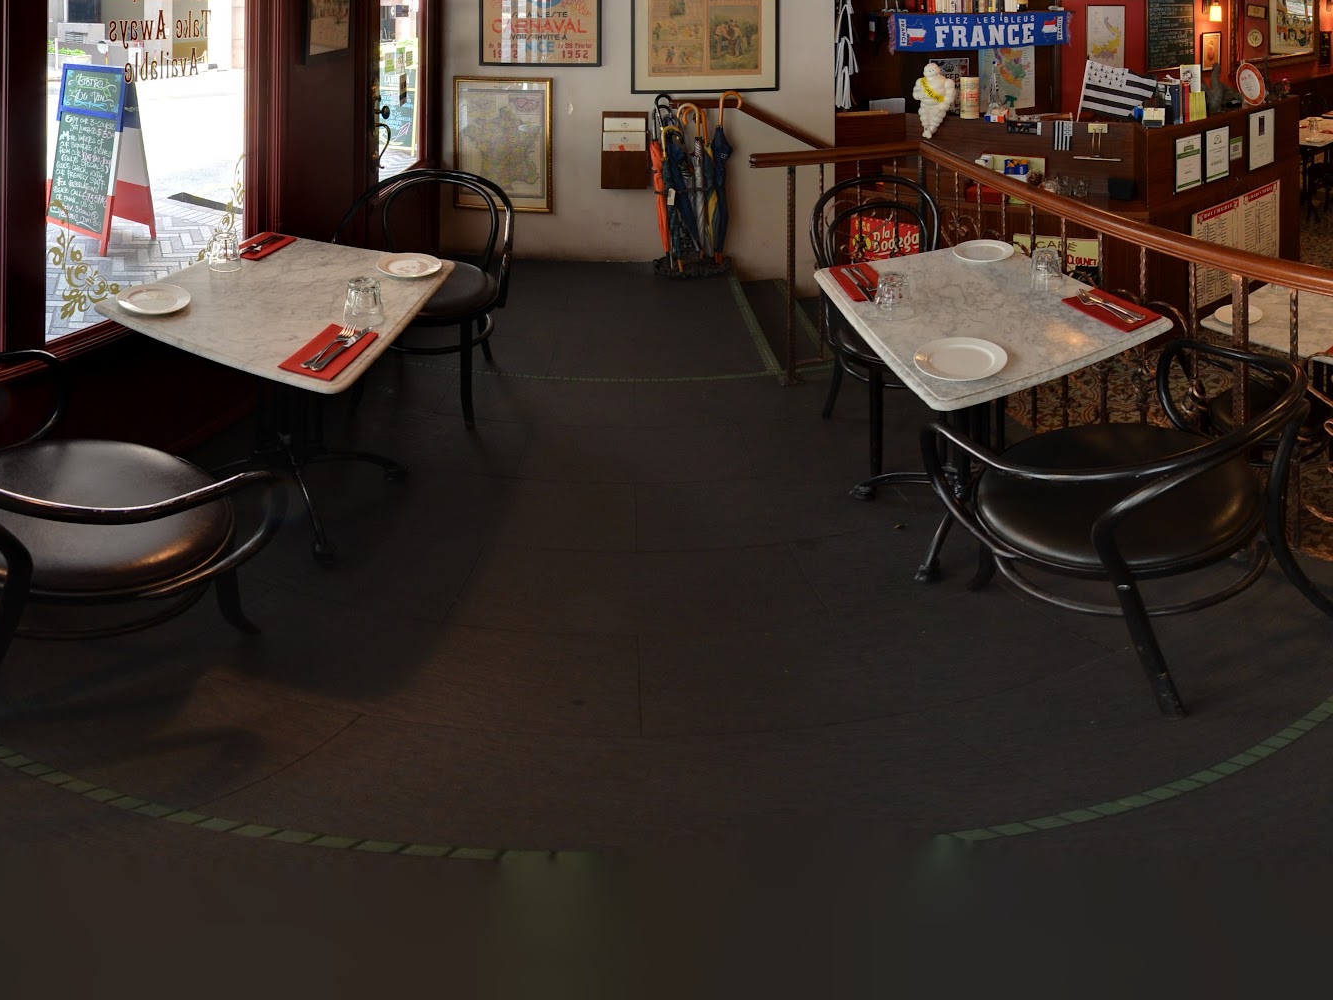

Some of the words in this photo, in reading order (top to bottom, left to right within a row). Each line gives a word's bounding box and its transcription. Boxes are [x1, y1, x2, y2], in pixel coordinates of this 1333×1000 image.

[934, 17, 968, 25] ALLEZ
[977, 16, 996, 24] LES
[1004, 14, 1035, 23] BLEUS
[899, 20, 907, 45] FRANCE
[934, 23, 1035, 48] FRANCE
[493, 50, 518, 58] 192
[562, 50, 589, 58] 1952
[921, 80, 940, 100] MICHELIN
[882, 226, 891, 238] la
